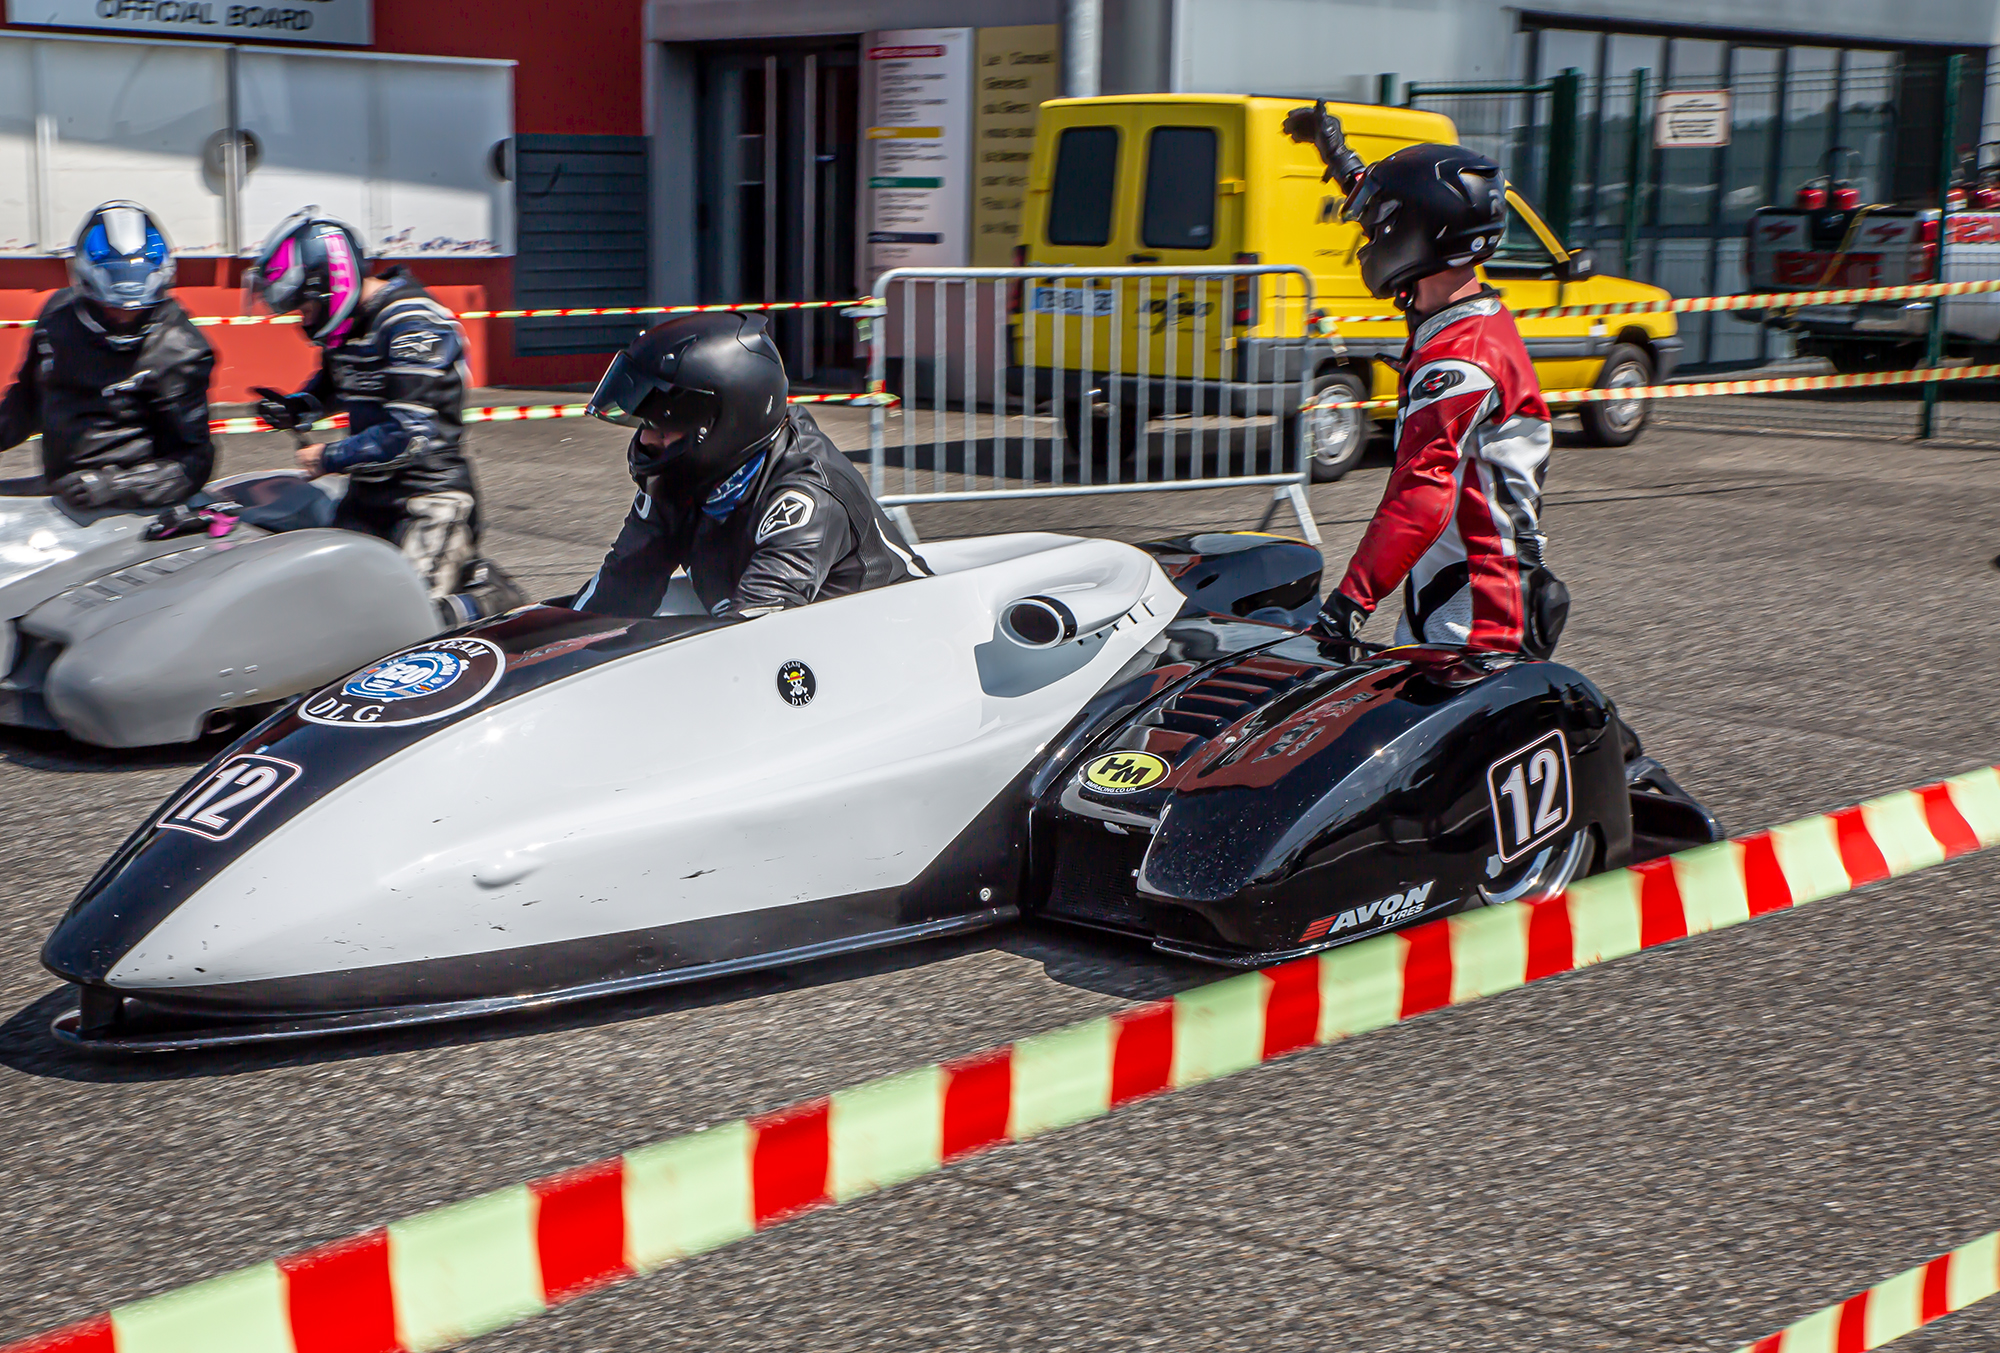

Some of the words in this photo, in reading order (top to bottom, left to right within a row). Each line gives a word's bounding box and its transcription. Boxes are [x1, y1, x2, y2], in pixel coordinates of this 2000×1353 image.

[95, 0, 218, 24] OFFICIAL
[224, 5, 314, 31] BOARD
[428, 639, 490, 659] TEAM
[783, 661, 801, 671] TEAM
[1097, 757, 1152, 785] HM
[174, 763, 278, 830] 12
[1500, 748, 1562, 846] 12
[1328, 880, 1436, 934] AVON
[1382, 902, 1425, 926] TYRES
